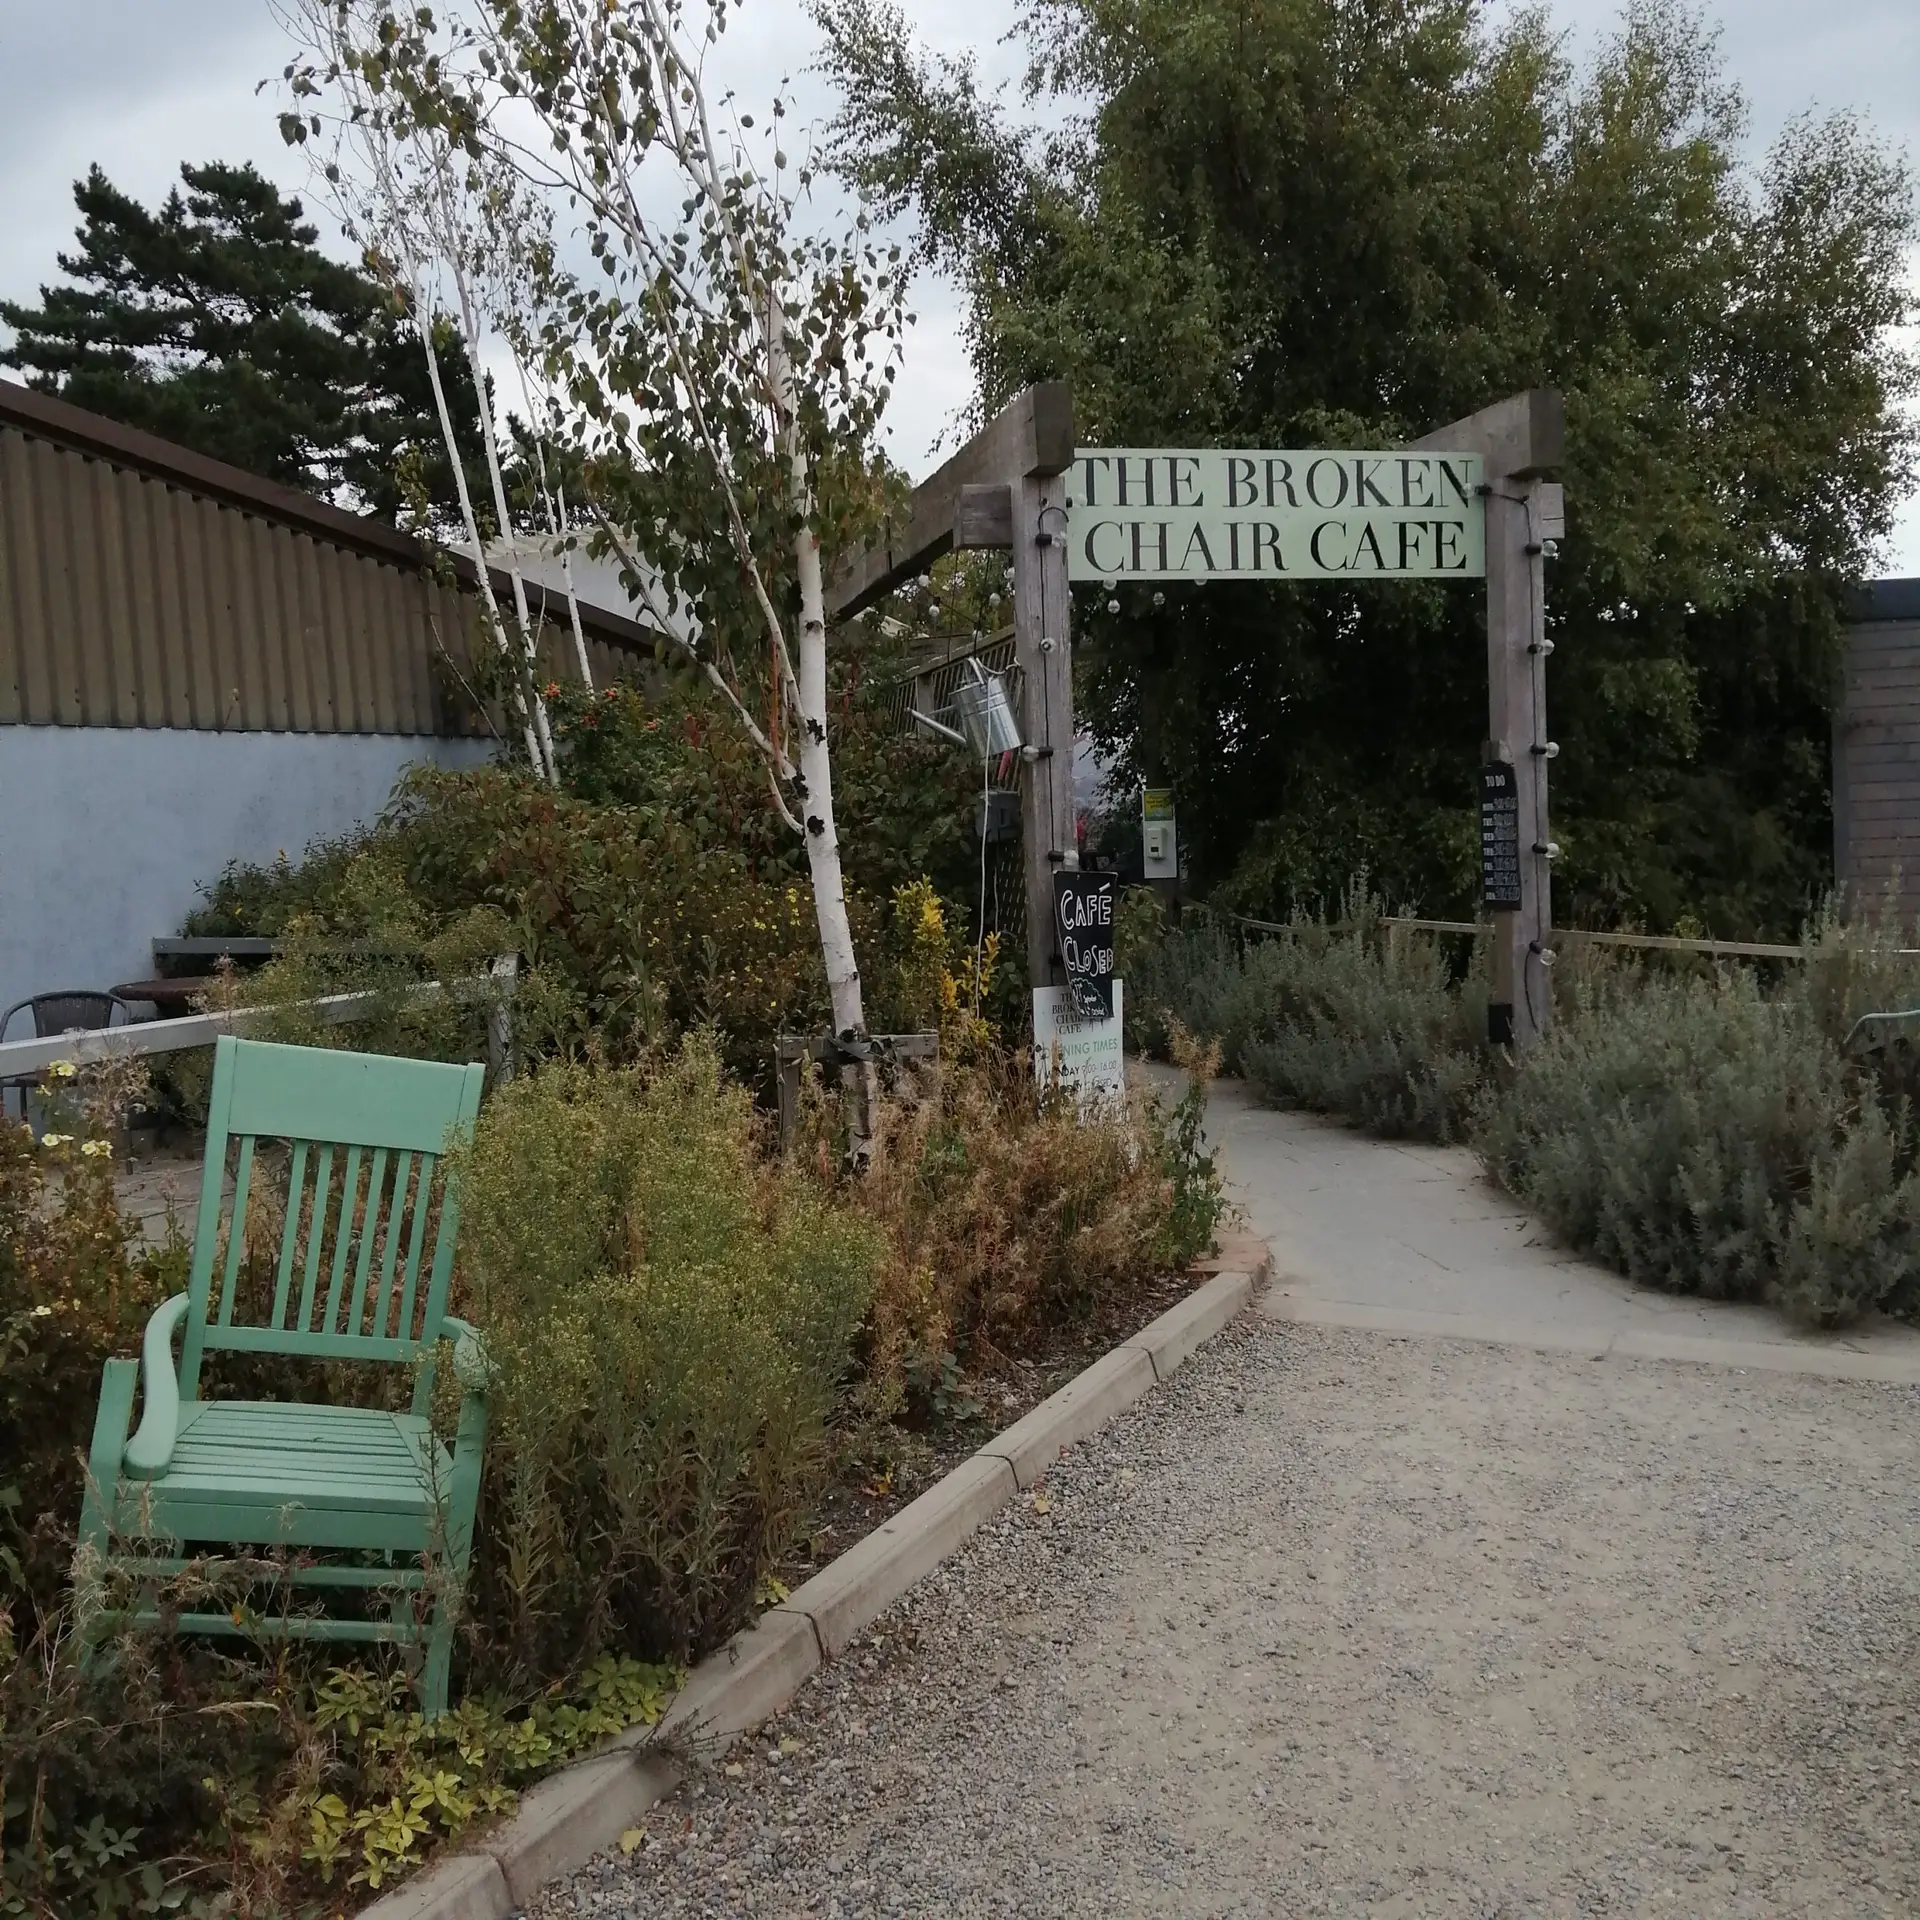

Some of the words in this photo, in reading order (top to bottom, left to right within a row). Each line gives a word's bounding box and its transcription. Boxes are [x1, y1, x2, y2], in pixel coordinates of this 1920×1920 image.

[1070, 456, 1204, 507] THE
[1224, 459, 1474, 508] BROKEN
[1084, 520, 1290, 573] CHAIR
[1310, 521, 1468, 573] CAFE
[1060, 882, 1112, 930] CAFÉ
[1060, 992, 1073, 1003] TH
[1052, 1003, 1076, 1015] BROK
[1058, 1023, 1082, 1035] CAFE
[1092, 1038, 1118, 1053] TIMES
